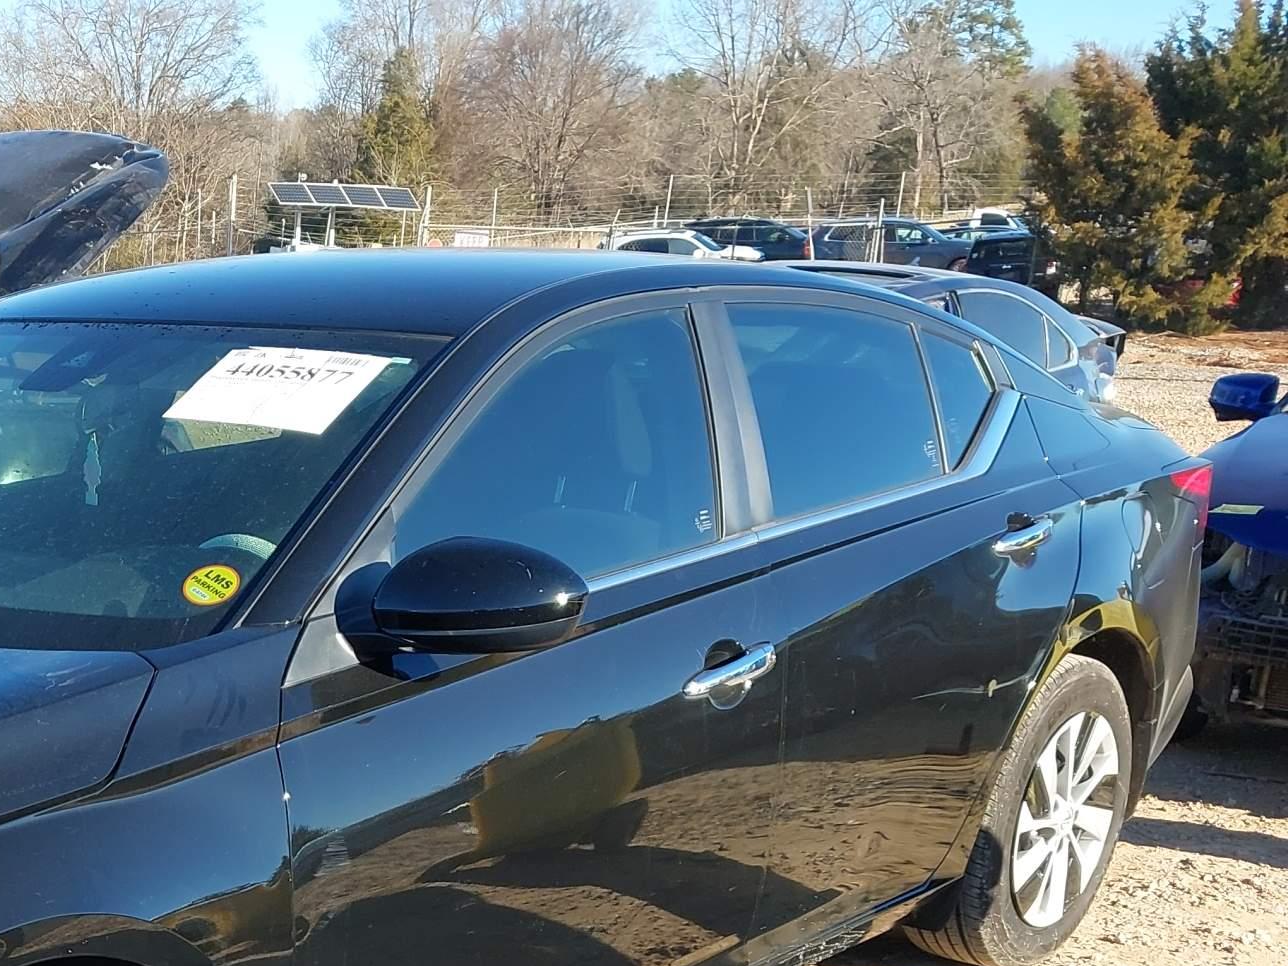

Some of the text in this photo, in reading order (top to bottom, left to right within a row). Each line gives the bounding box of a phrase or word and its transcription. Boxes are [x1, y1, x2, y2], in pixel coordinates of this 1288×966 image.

[226, 361, 354, 385] 44055877
[191, 575, 228, 599] PARKING
[203, 569, 234, 590] LMS
